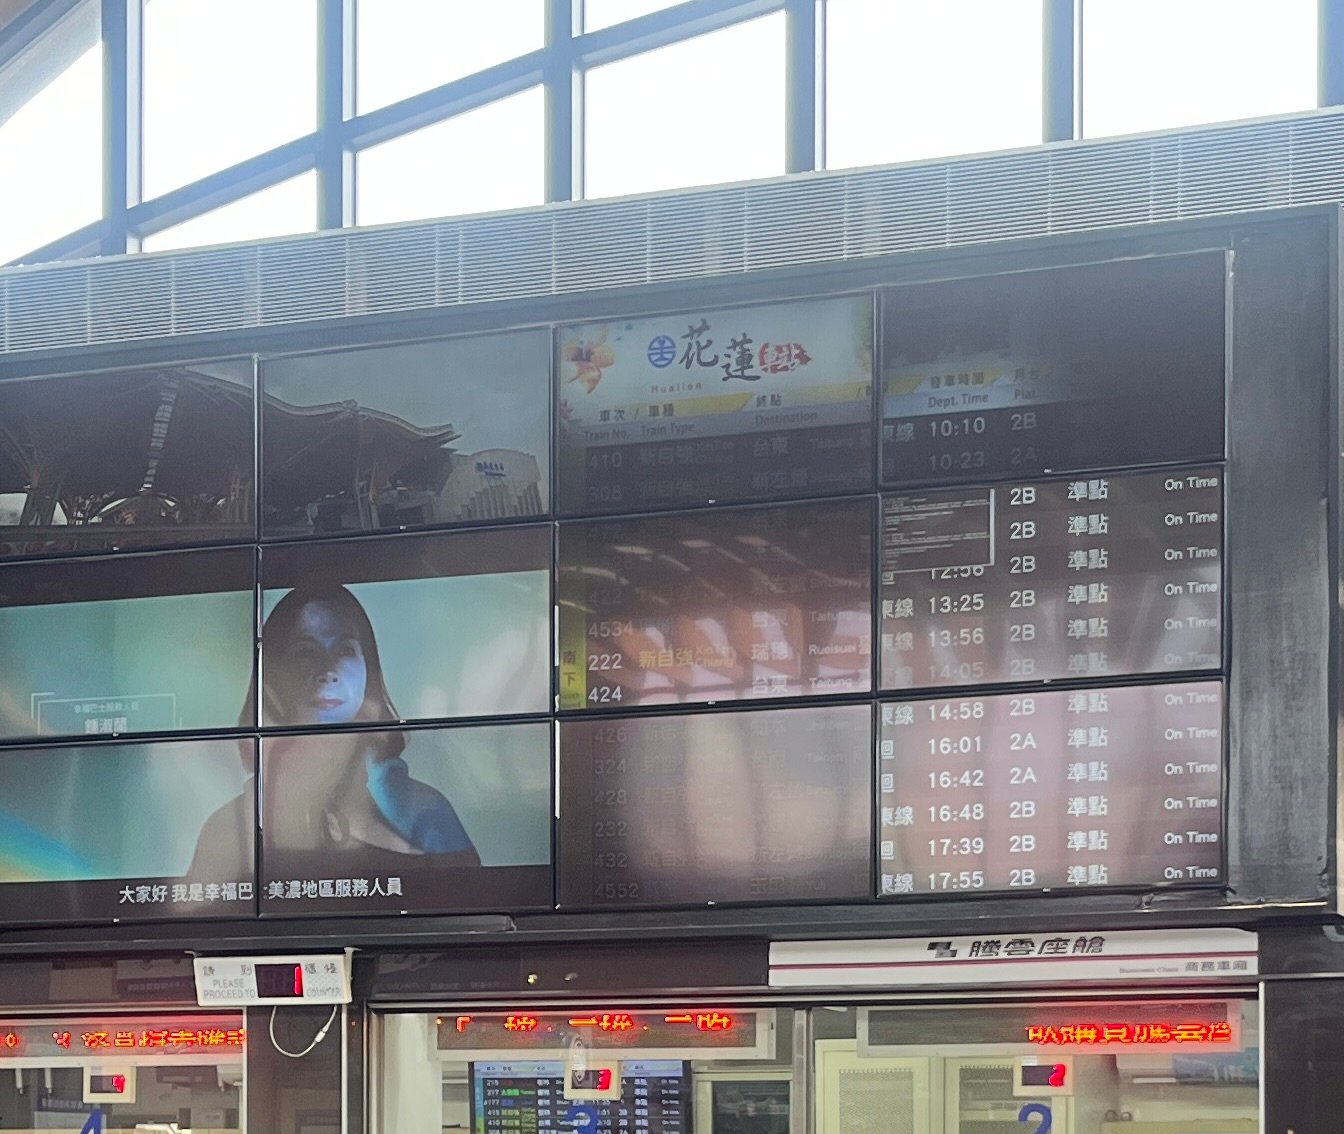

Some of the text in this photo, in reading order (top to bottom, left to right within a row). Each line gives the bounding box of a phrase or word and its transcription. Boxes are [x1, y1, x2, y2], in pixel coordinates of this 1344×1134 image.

[678, 318, 761, 382] 花蓮
[929, 417, 986, 438] 10:10
[1010, 487, 1036, 506] 2B
[1164, 478, 1183, 491] On
[1186, 476, 1218, 489] Time
[1010, 521, 1036, 540] 2B
[1164, 513, 1183, 525] On
[1186, 511, 1218, 523] Time
[1010, 556, 1036, 574] 2B
[928, 589, 1035, 614] 13:25 2B
[928, 624, 1035, 647] 13:56 2B
[588, 654, 622, 671] 222
[588, 687, 622, 703] 424
[928, 702, 984, 721] 14:58
[928, 733, 1036, 755] 16:01 2A
[928, 767, 1036, 789] 16:42 2A
[928, 804, 984, 822] 16:48
[928, 830, 1218, 857] 17:39 On Time
[928, 866, 1218, 890] 17:55 On Time
[119, 884, 168, 904] 大家好
[968, 935, 1106, 958] 騰雲座艙
[294, 966, 303, 995] 1
